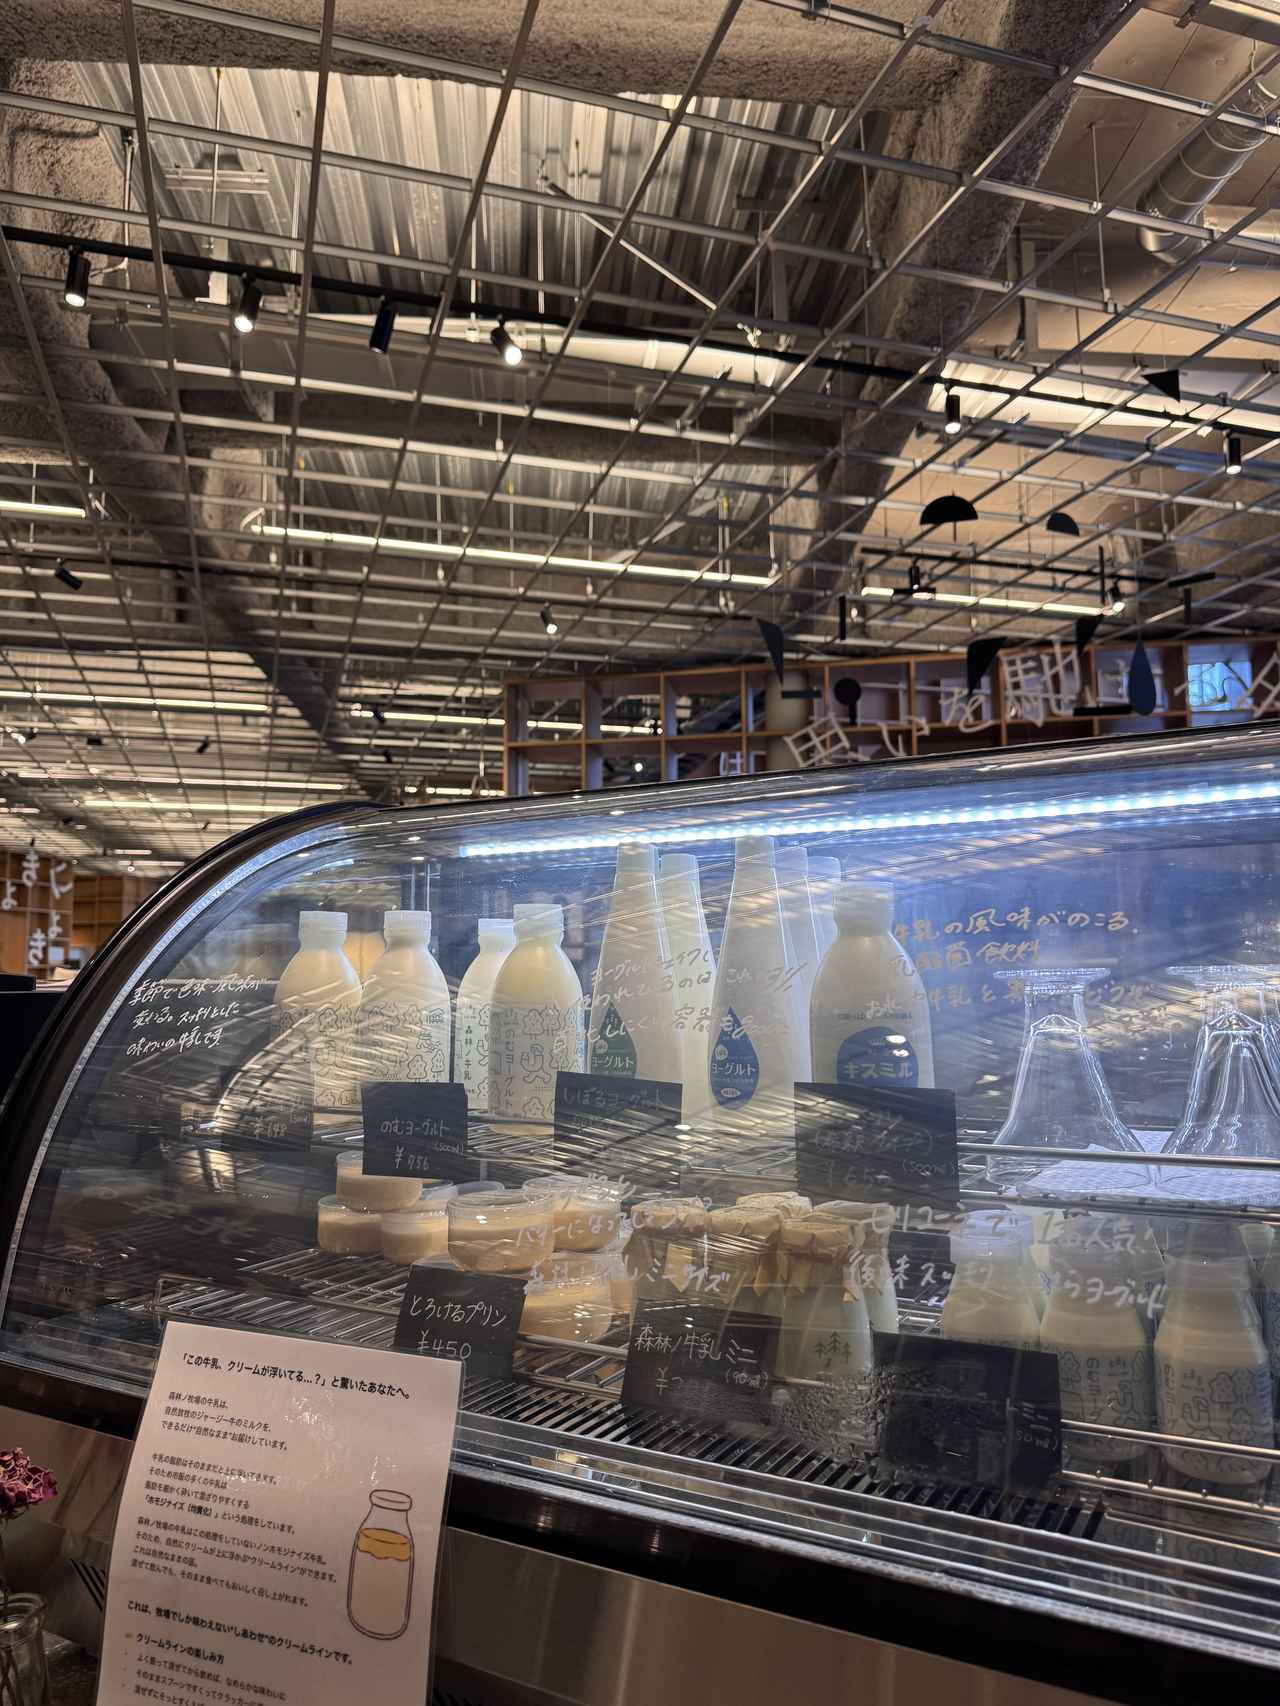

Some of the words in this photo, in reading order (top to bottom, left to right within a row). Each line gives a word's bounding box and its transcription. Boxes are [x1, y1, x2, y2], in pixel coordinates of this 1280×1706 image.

[380, 1114, 451, 1137] のむヨーグルト
[409, 1295, 507, 1328] とろけるプリン
[416, 1329, 472, 1360] ¥450
